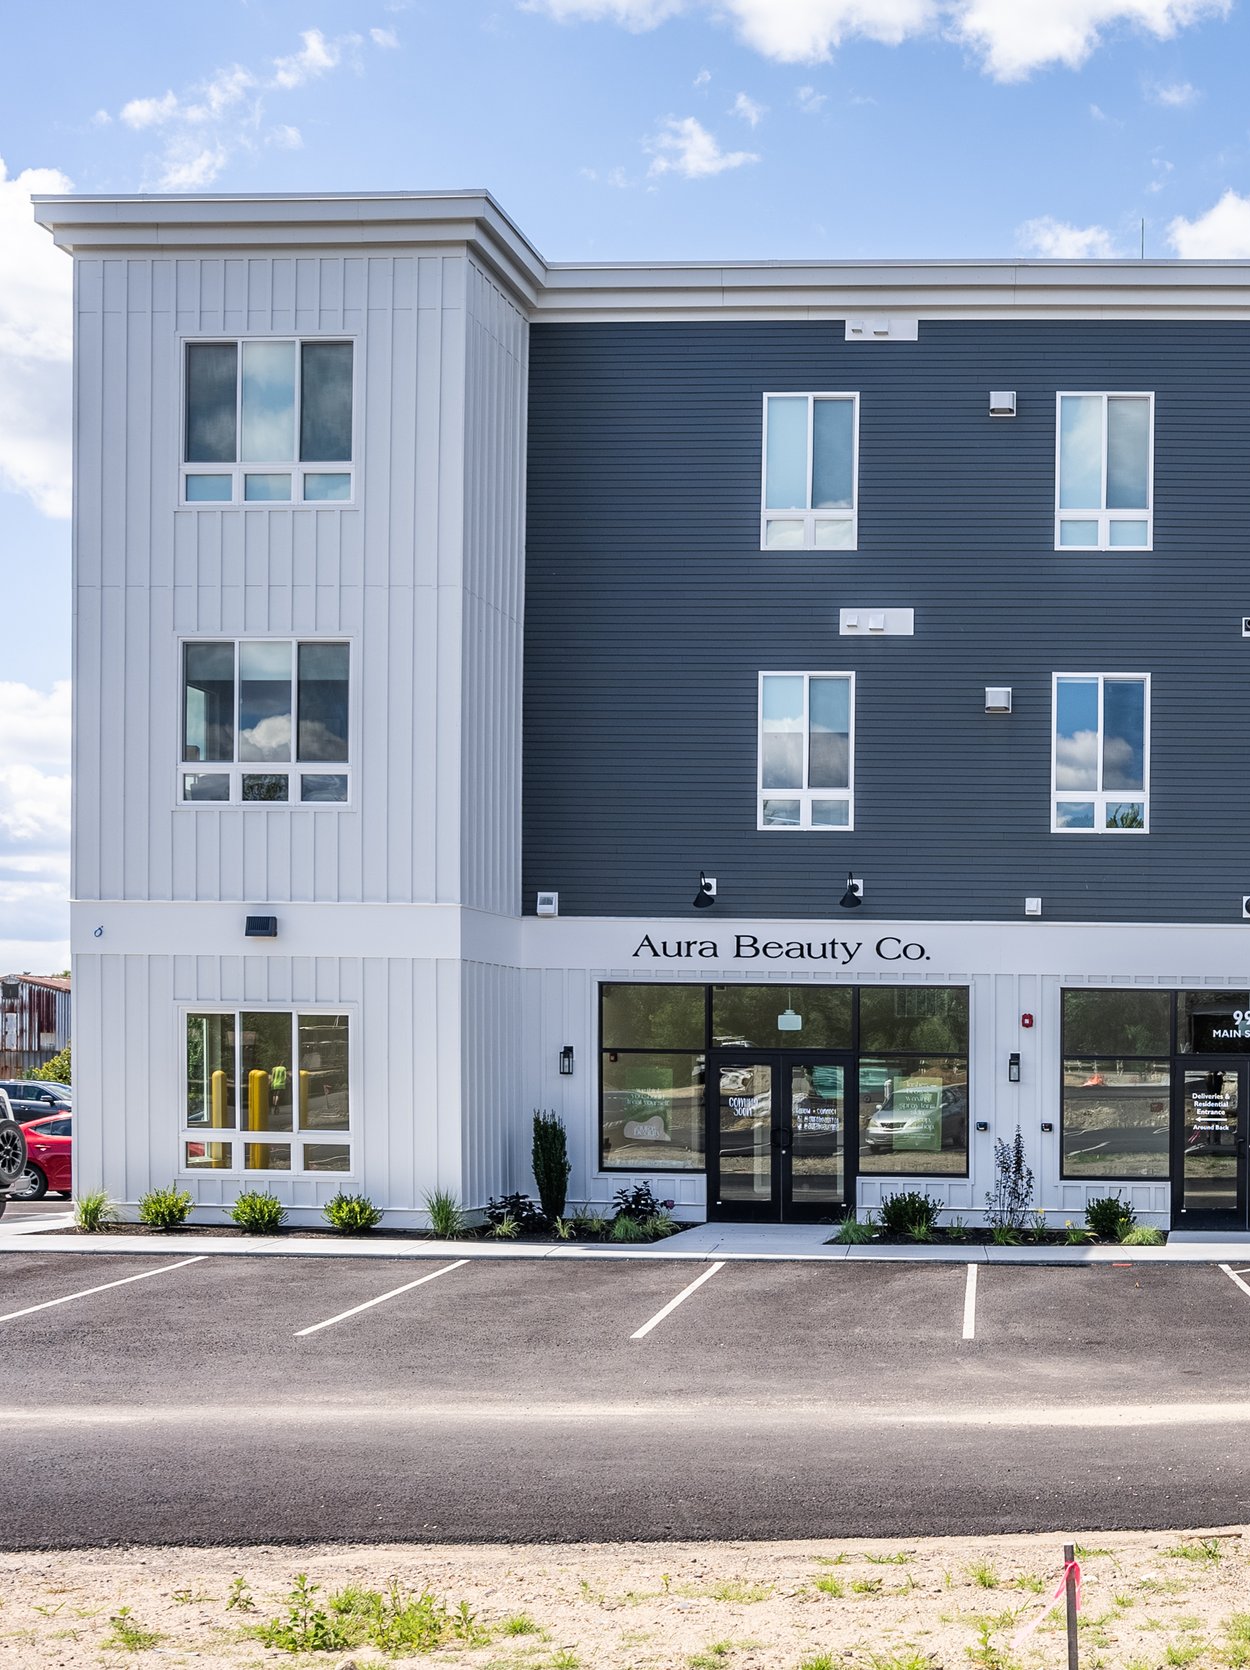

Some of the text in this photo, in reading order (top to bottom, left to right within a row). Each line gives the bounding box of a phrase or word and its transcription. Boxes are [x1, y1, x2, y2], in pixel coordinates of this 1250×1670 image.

[632, 934, 932, 965] Aura Beauty Co.
[1212, 1029, 1242, 1038] MAIN
[1192, 1092, 1223, 1100] Deliveries
